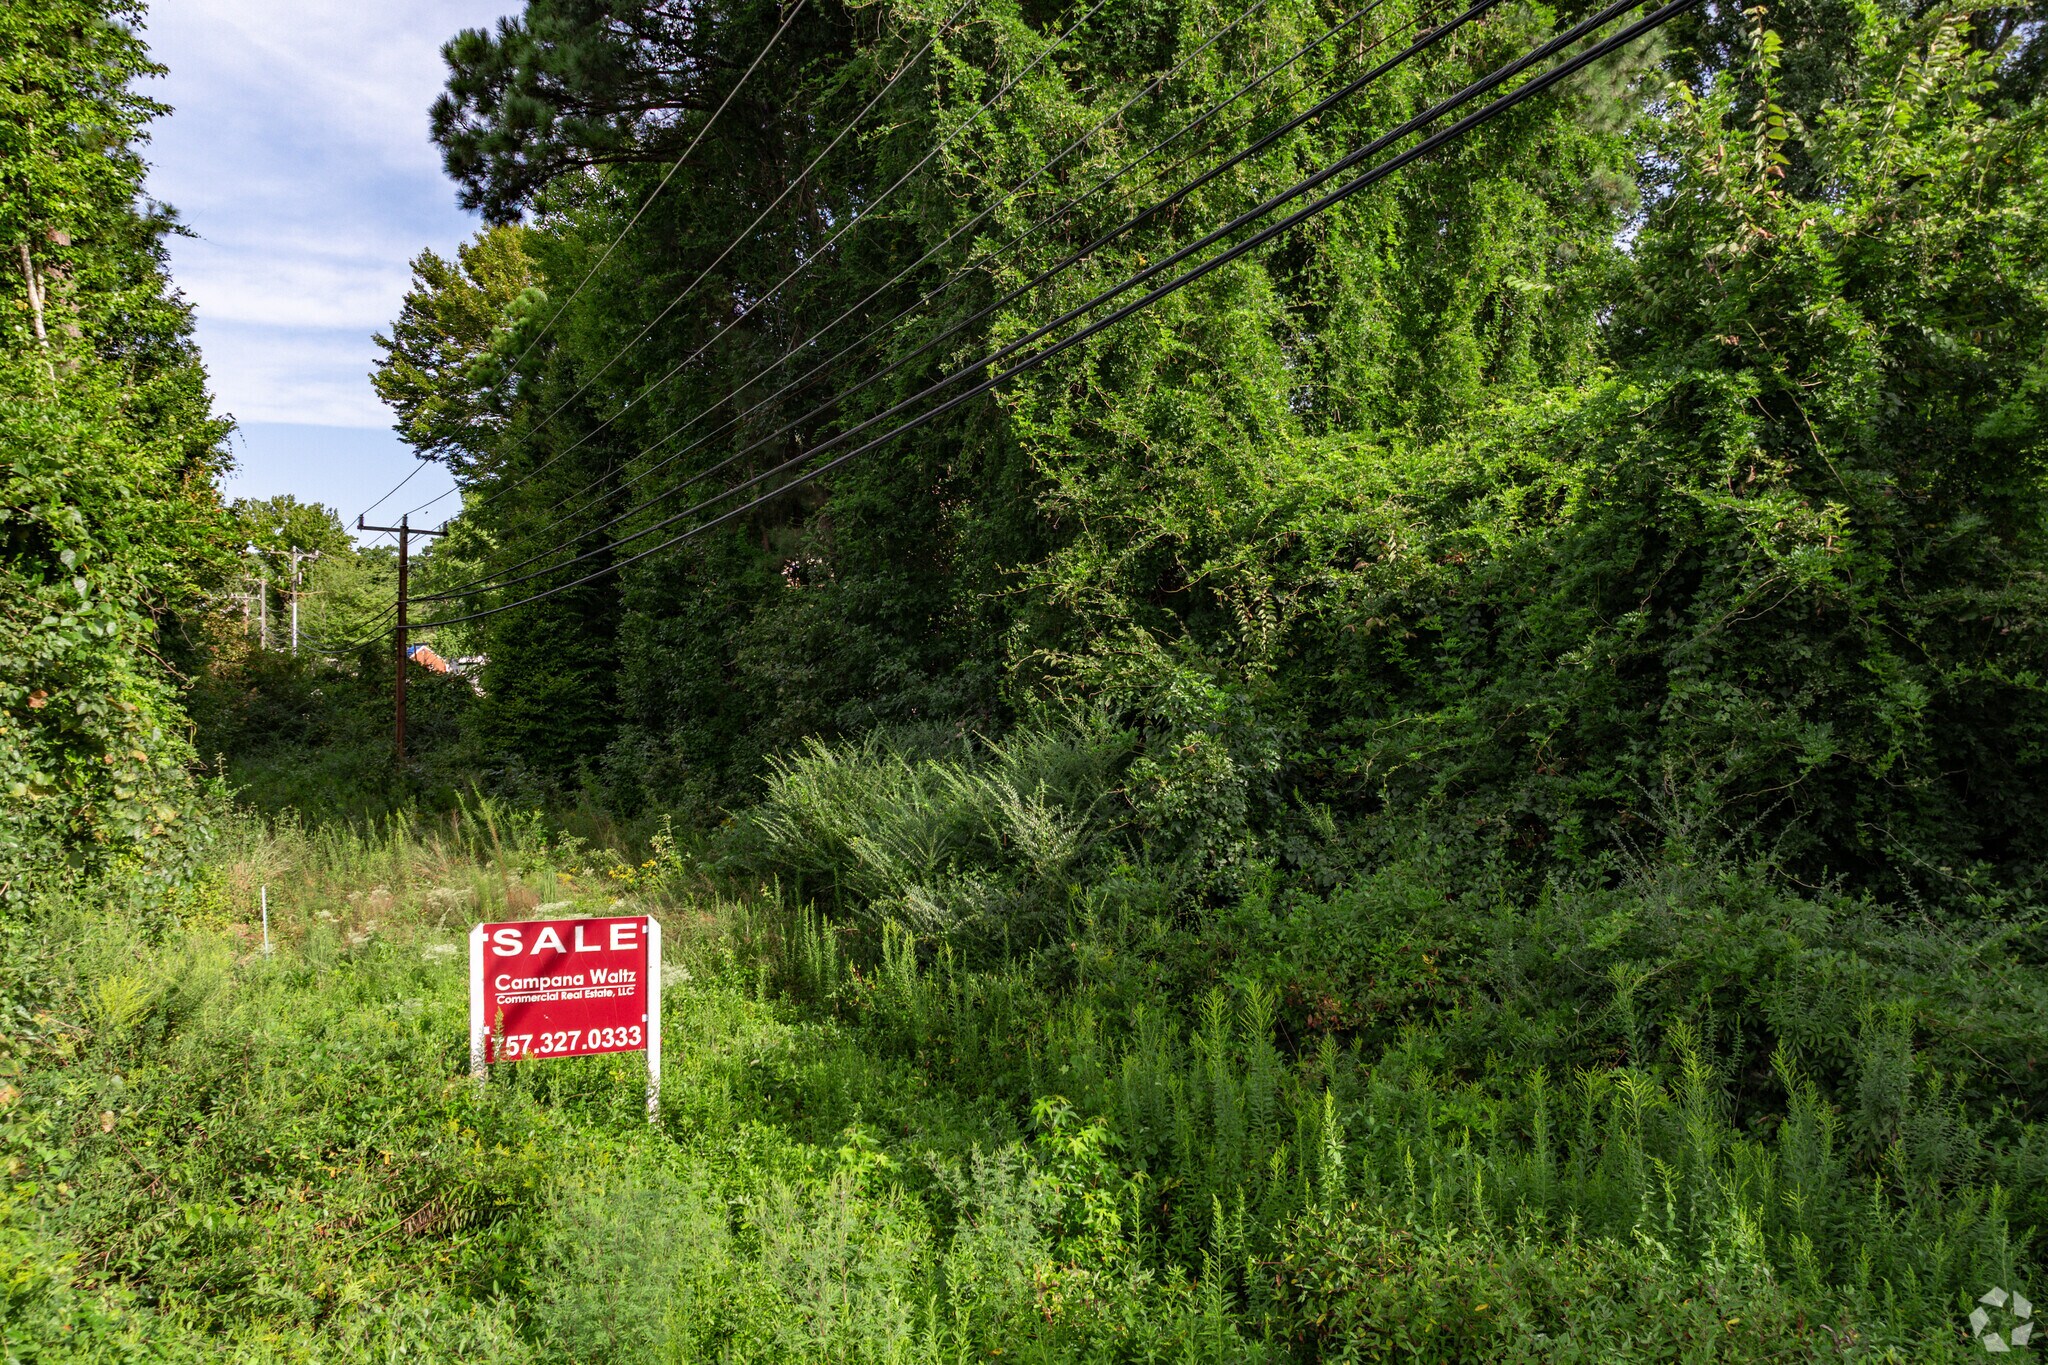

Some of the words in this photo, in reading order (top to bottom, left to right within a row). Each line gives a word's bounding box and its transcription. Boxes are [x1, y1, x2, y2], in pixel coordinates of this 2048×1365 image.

[492, 923, 638, 957] SALE
[495, 974, 584, 991] Campana
[590, 968, 636, 985] Waltz
[496, 993, 559, 1005] Commercial
[561, 990, 582, 1000] Real
[584, 988, 615, 999] Estate,
[617, 987, 635, 996] LLC
